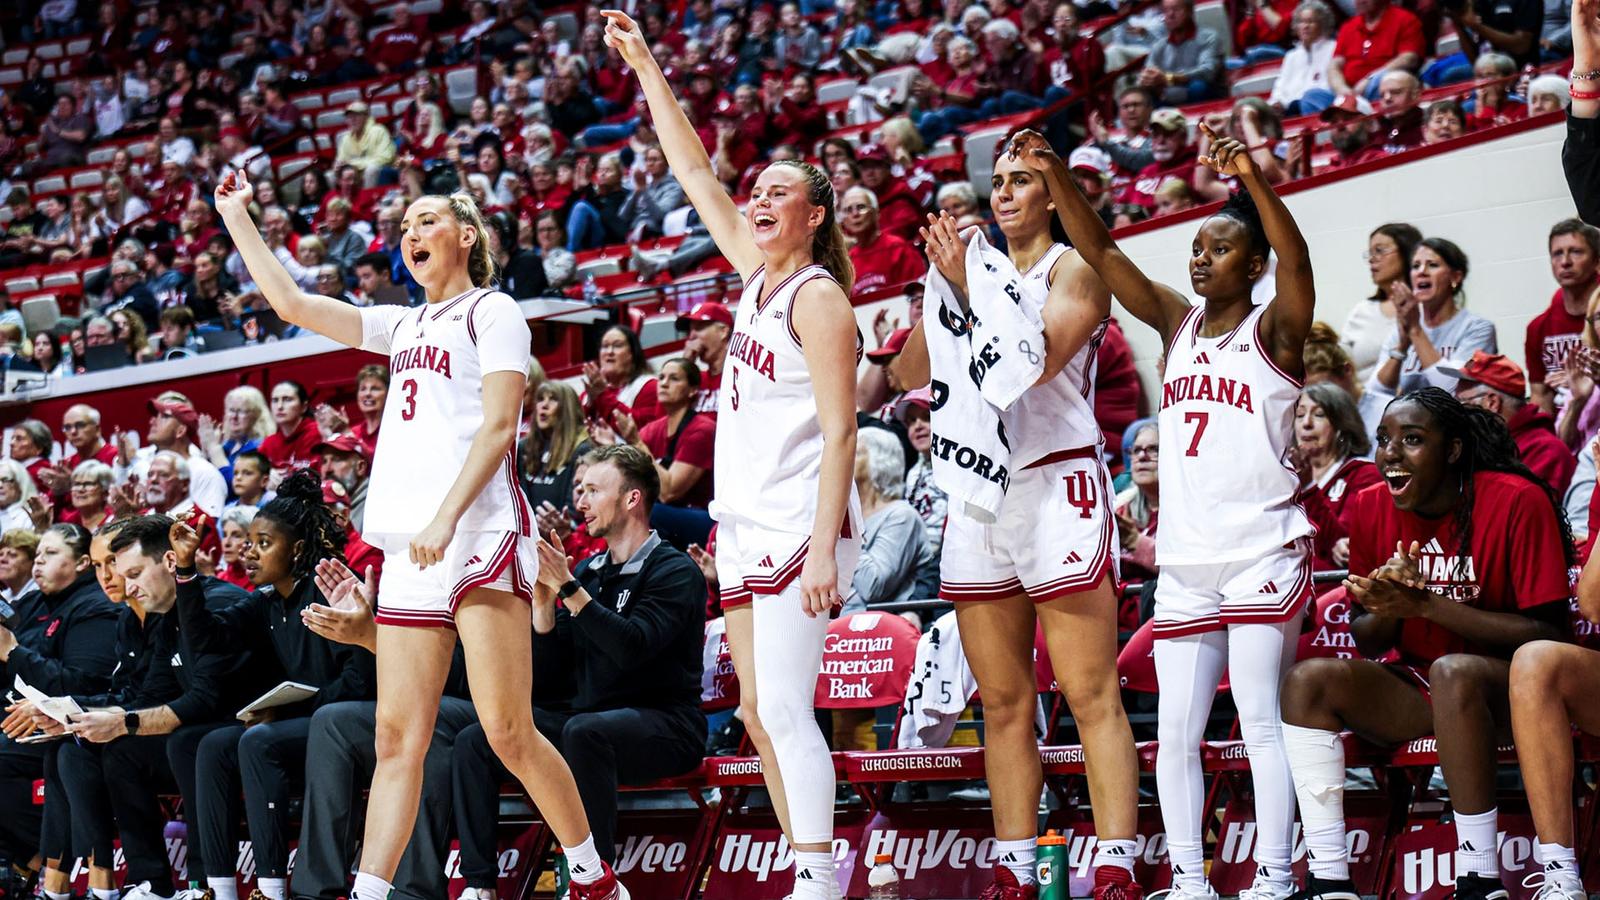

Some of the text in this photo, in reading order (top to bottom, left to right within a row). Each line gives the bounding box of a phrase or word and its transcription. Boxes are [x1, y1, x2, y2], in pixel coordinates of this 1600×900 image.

[401, 378, 418, 421] 3
[731, 365, 740, 411] 5
[1184, 412, 1209, 457] 7
[823, 633, 893, 653] German
[828, 677, 873, 699] Bank
[940, 680, 952, 704] 5
[719, 834, 850, 882] HyVe
